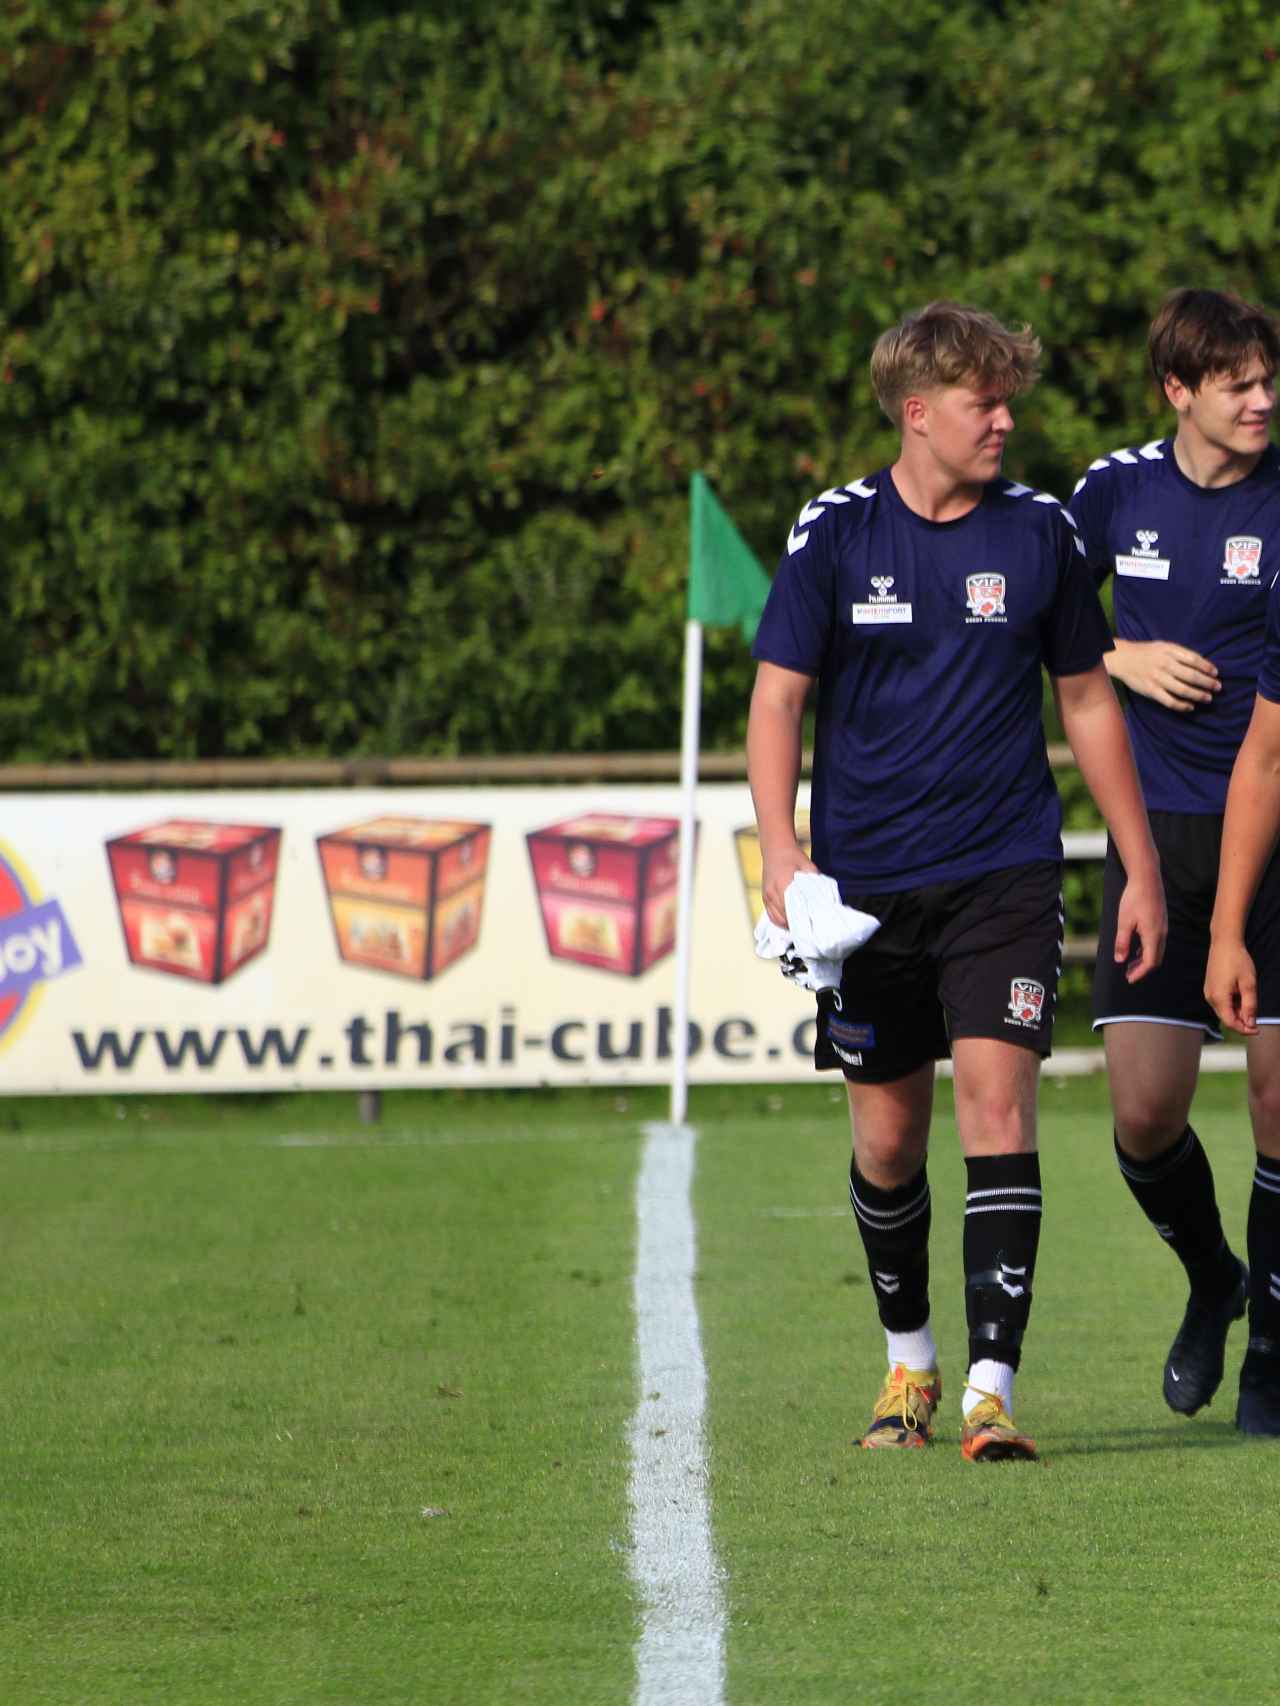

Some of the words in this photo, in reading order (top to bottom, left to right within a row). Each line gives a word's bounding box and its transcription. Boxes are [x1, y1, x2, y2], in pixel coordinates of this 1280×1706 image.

[972, 578, 1002, 587] VIF
[0, 917, 62, 980] oy
[1017, 983, 1041, 994] VIF
[71, 1006, 817, 1069] www.thai-cube.c
